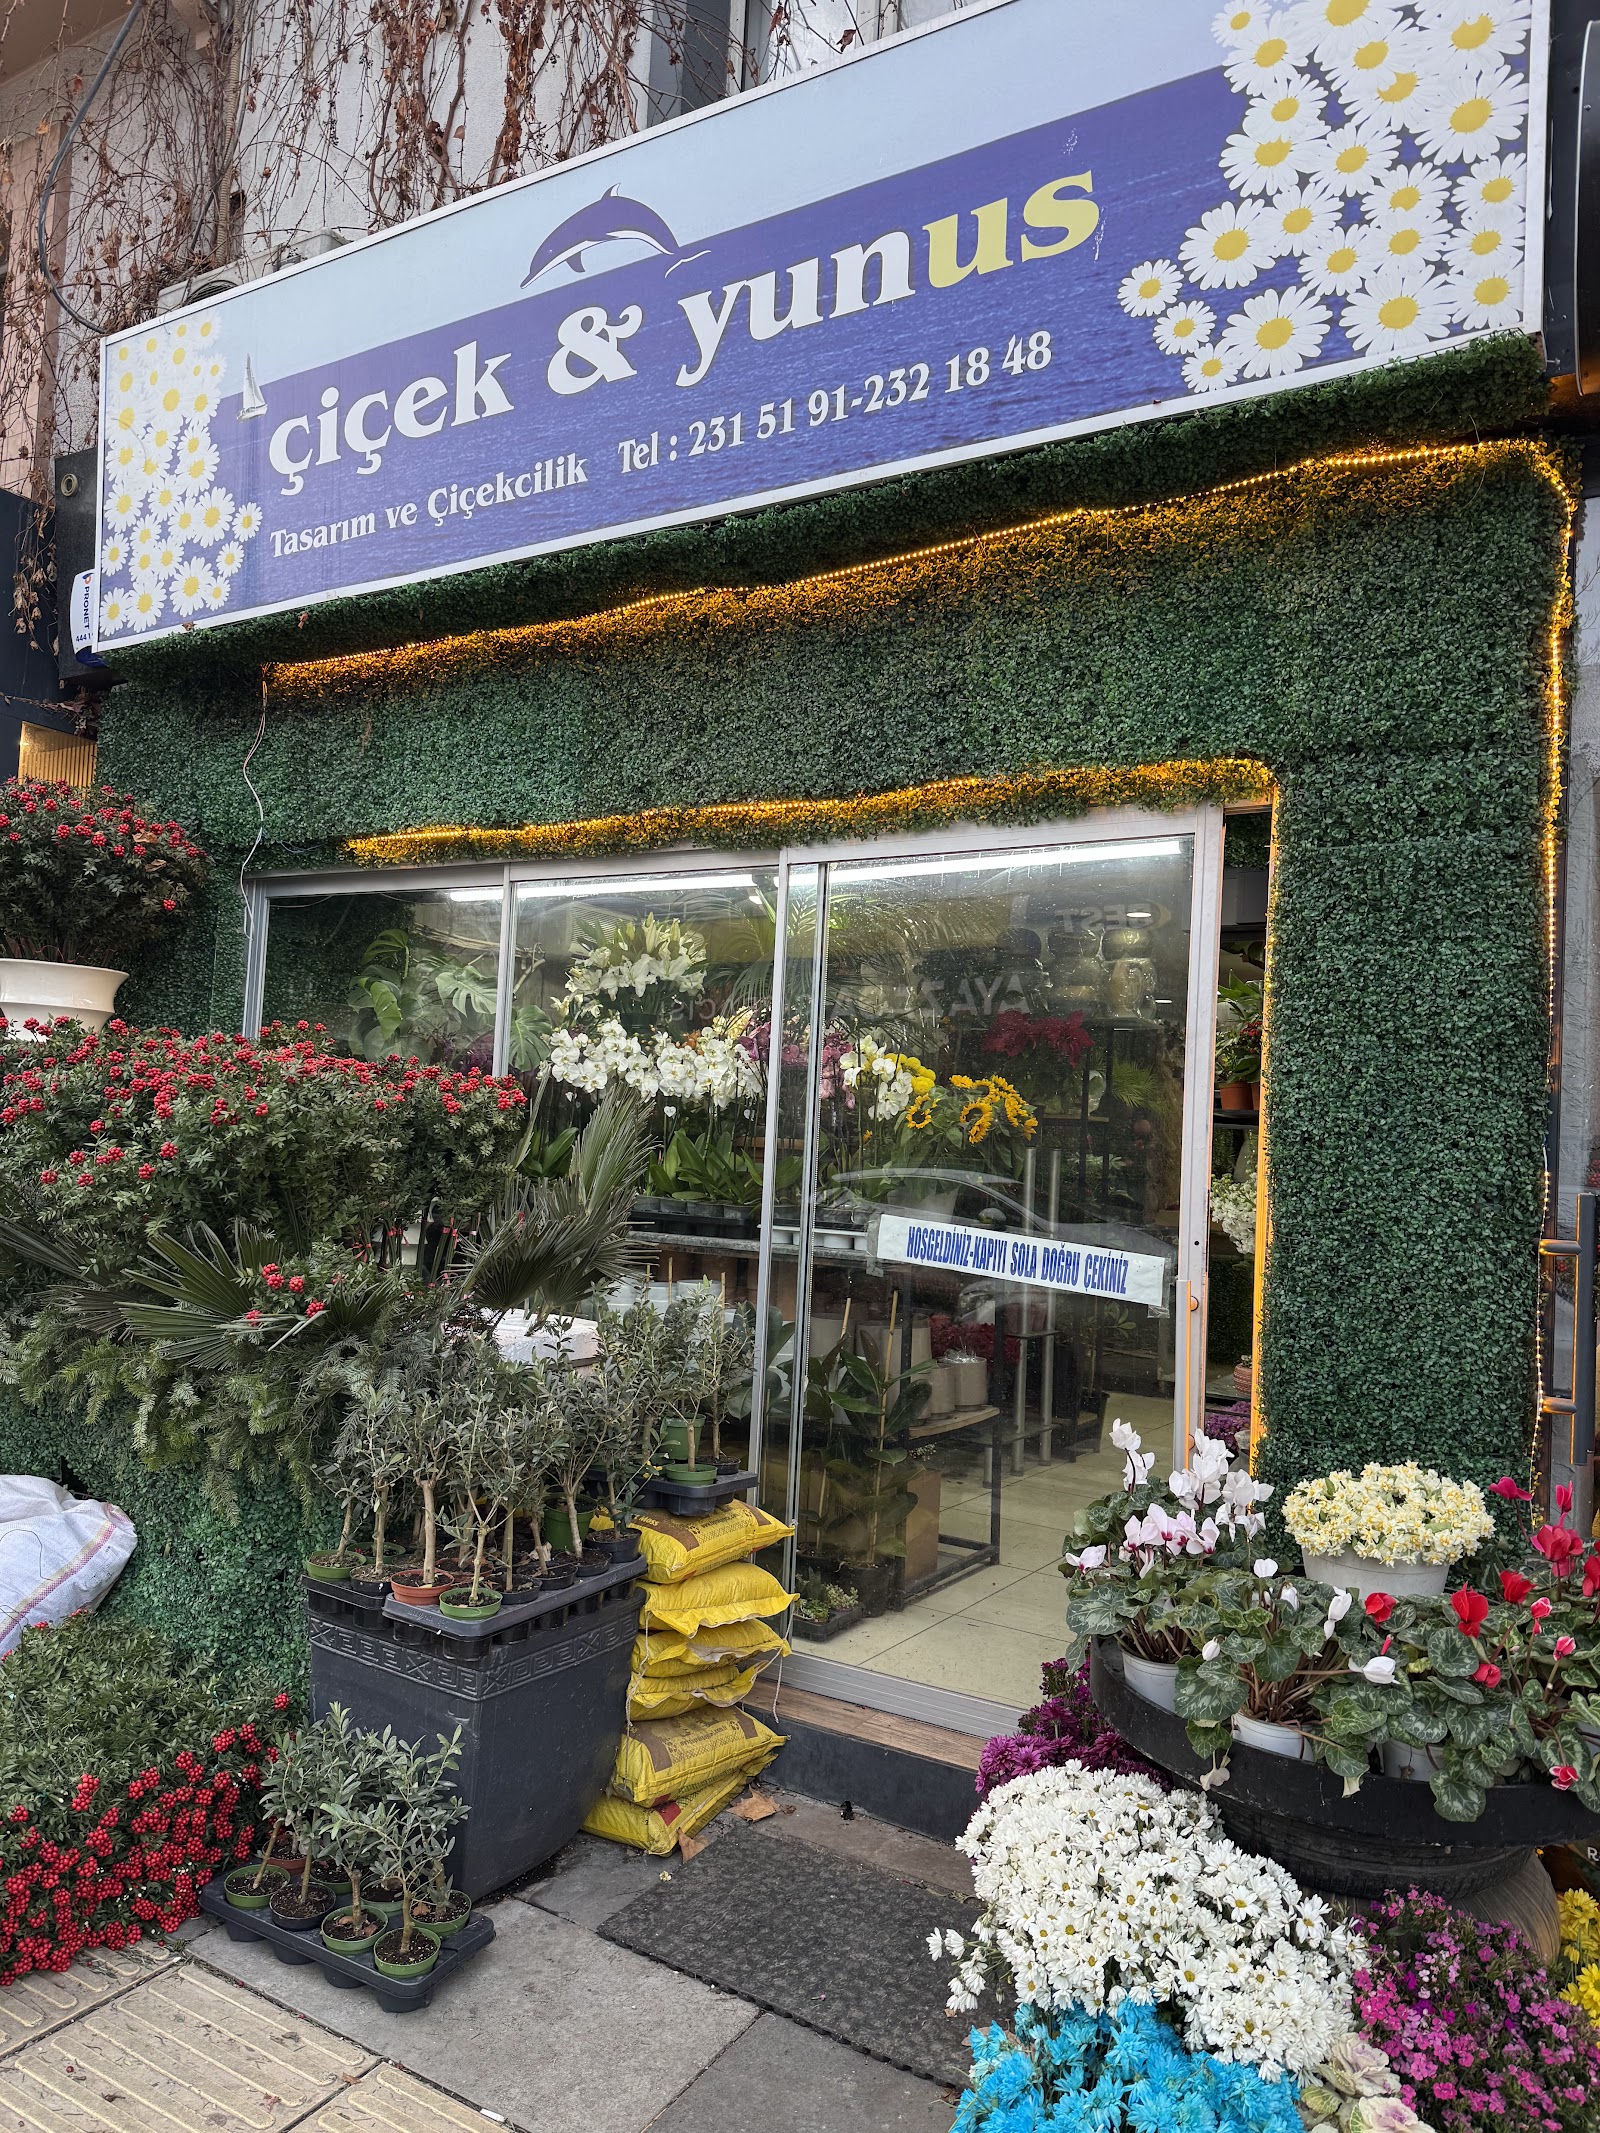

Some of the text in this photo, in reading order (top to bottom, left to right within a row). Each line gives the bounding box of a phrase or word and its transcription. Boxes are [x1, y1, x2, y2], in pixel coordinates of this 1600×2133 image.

[269, 170, 1099, 495] çiçek & yunus
[688, 411, 745, 456] 231
[757, 397, 795, 438] 51
[808, 363, 930, 426] 91-232
[945, 347, 989, 393] 18
[1002, 330, 1051, 375] 48
[270, 453, 588, 557] Tasarım ve Çiçekcilik
[75, 634, 87, 642] 444
[906, 1226, 1129, 1295] HOŞGELDİNİZ-KAPIYI SOLA DOĞRU ÇEKİNİZ
